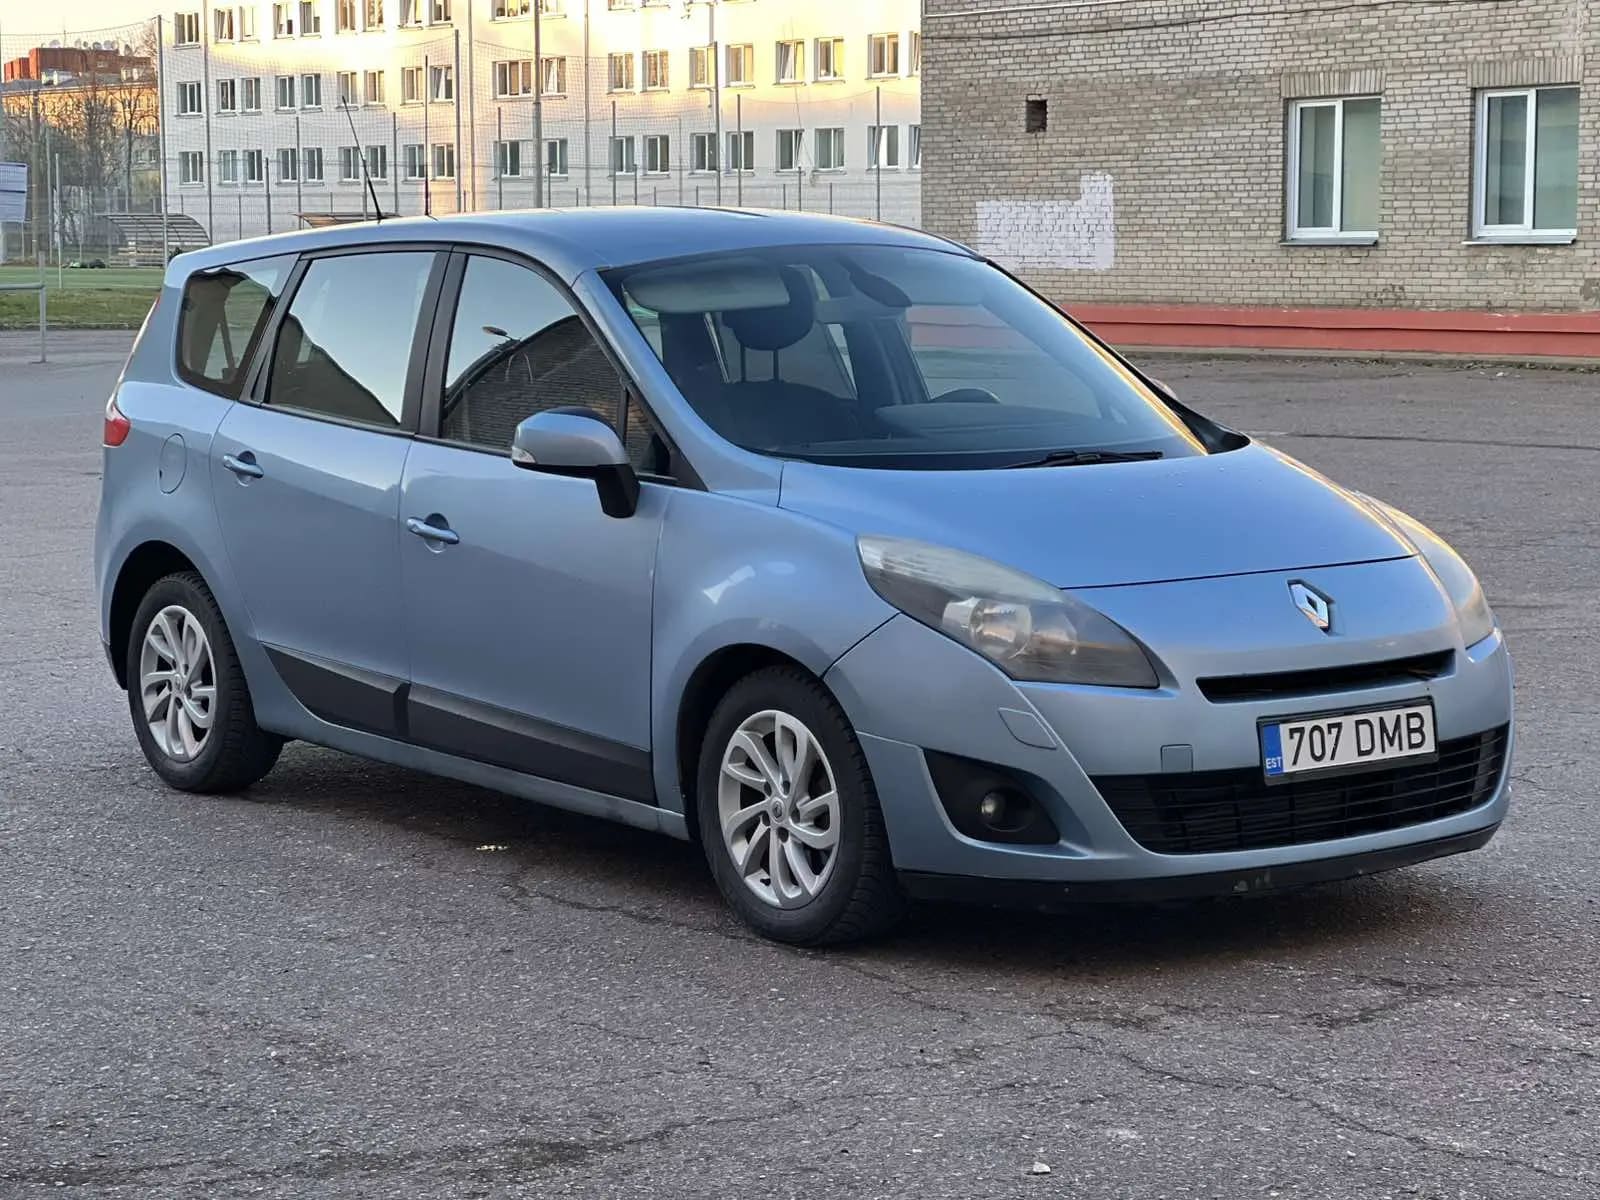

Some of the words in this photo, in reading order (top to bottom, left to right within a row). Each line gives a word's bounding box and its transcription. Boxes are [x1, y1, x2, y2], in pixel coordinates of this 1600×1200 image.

[1289, 721, 1343, 766] 707
[1355, 712, 1426, 757] DMB
[1265, 756, 1282, 769] EST
